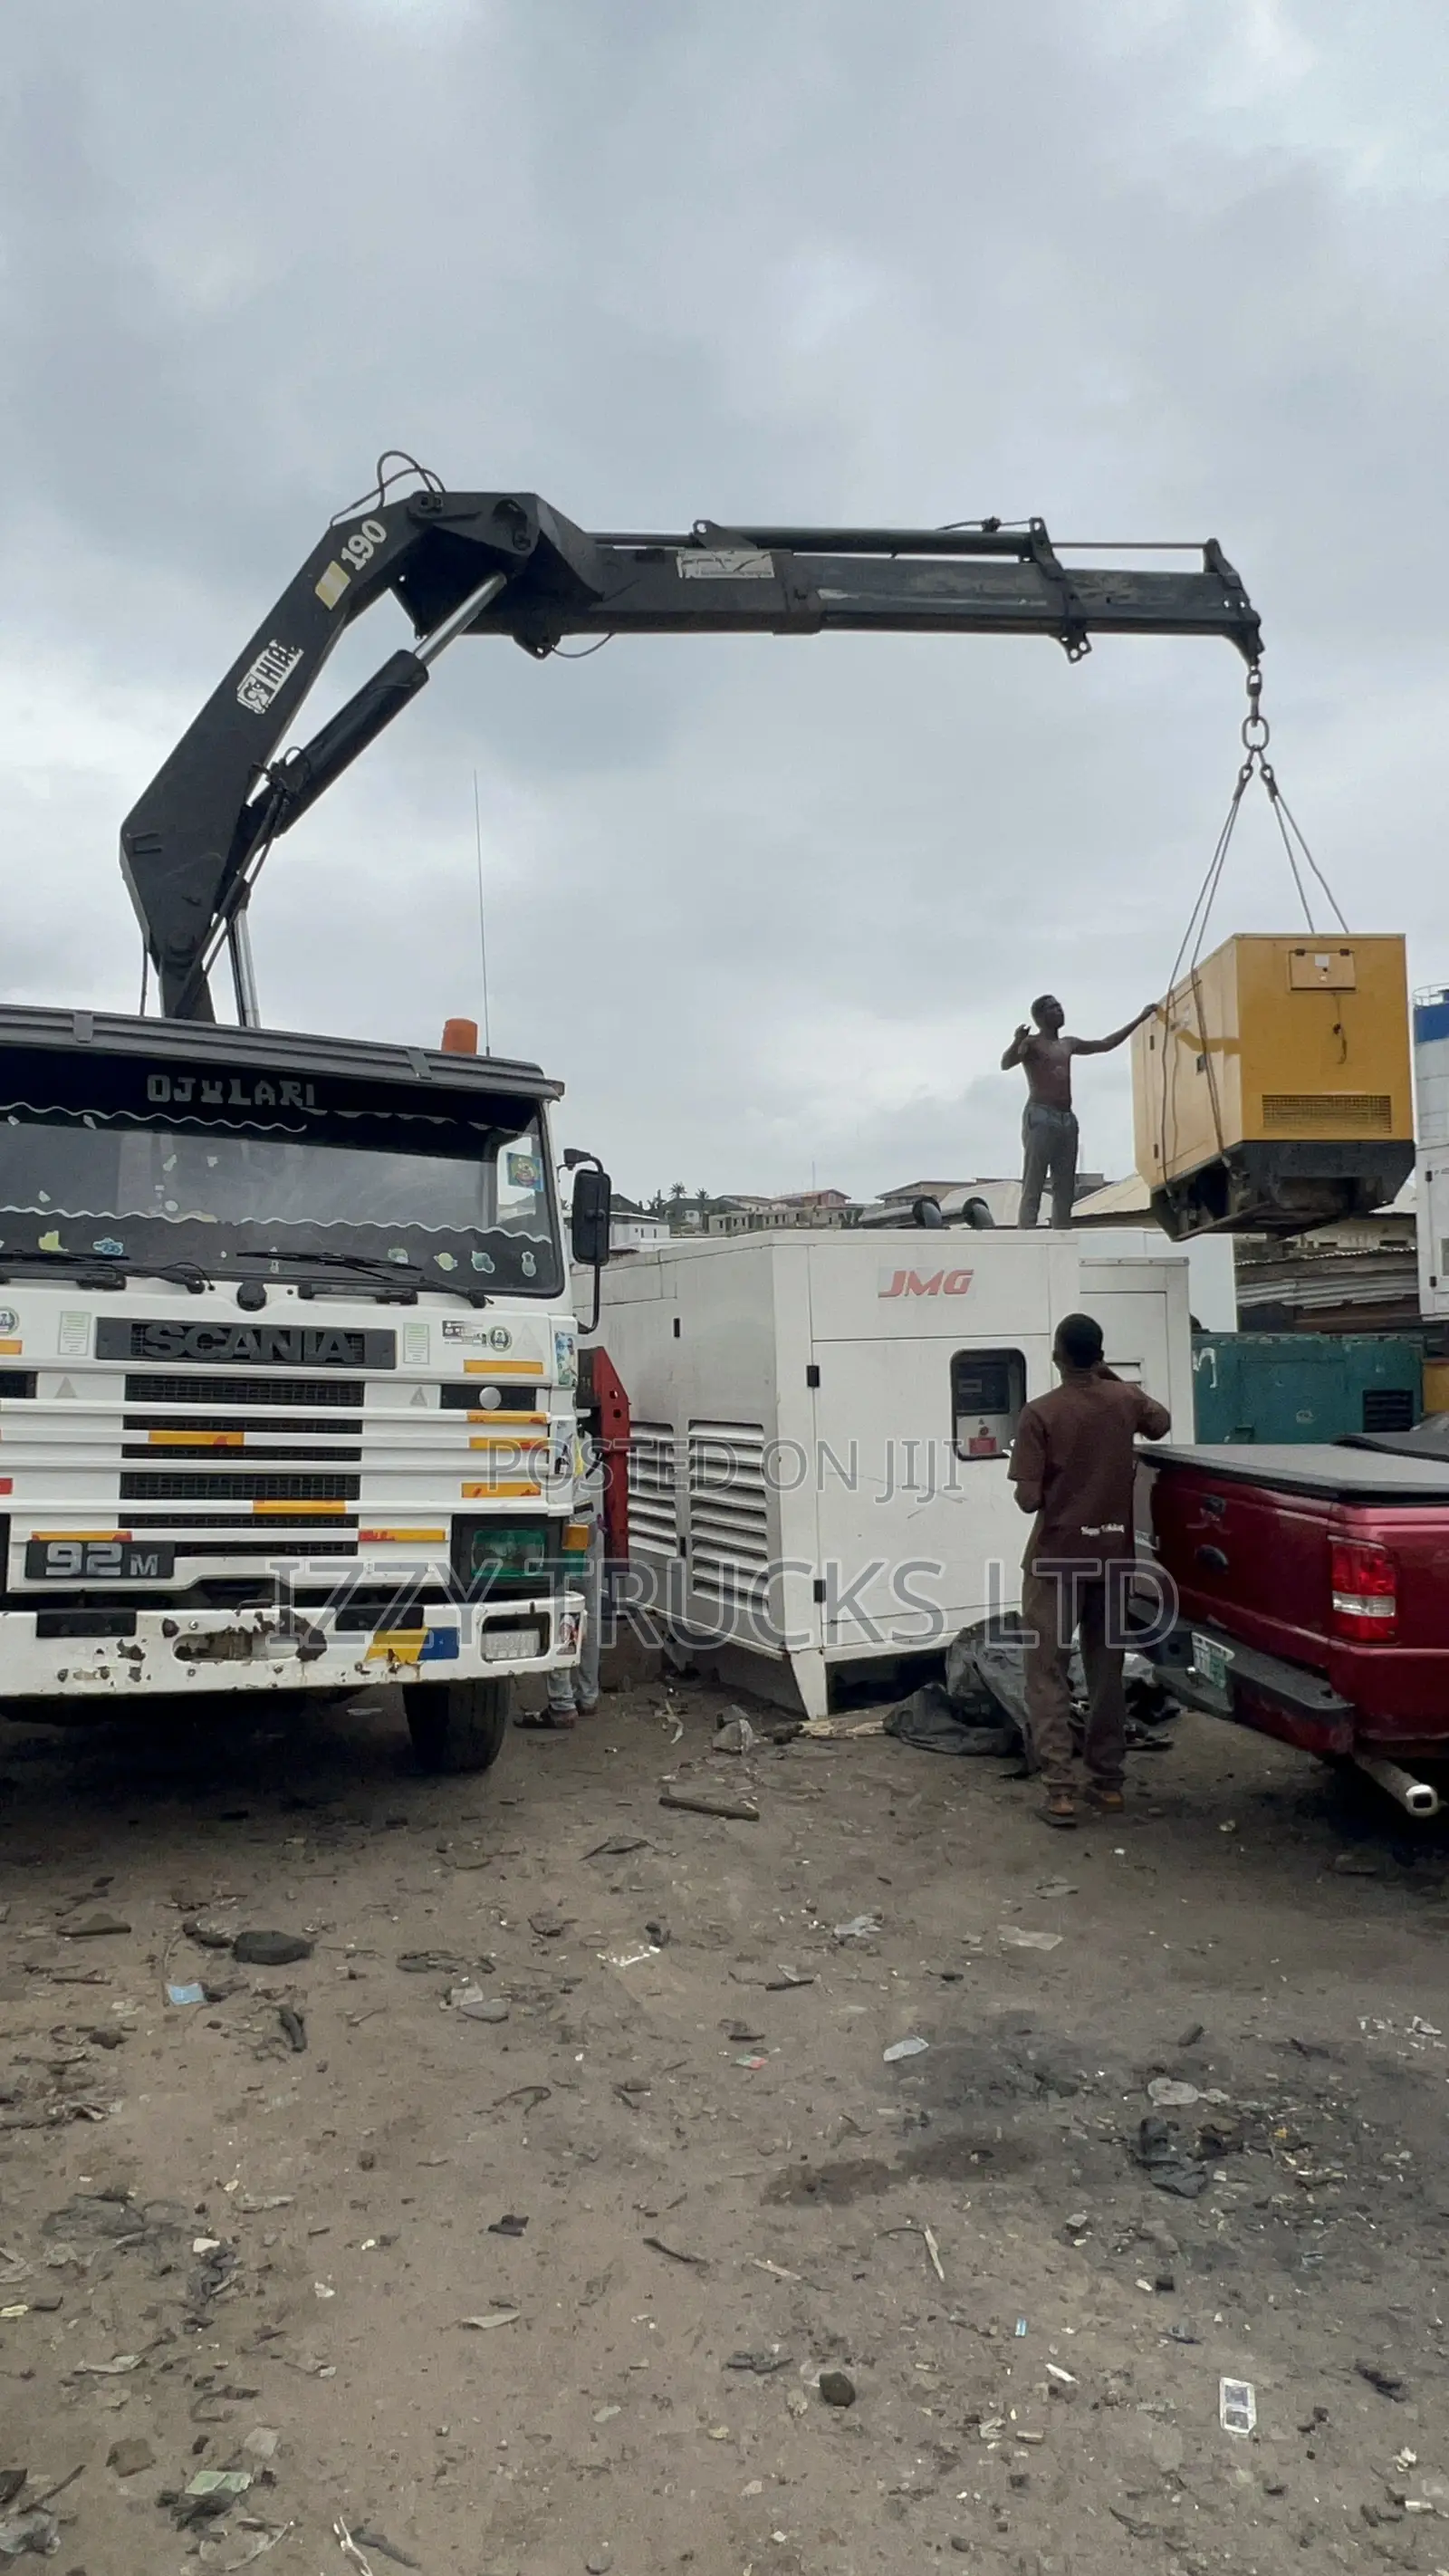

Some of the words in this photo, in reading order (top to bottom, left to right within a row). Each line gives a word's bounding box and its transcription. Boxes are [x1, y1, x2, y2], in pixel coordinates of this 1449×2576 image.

[341, 519, 387, 571] 190
[878, 1269, 974, 1298] JMG
[143, 1322, 360, 1363] SCANIA
